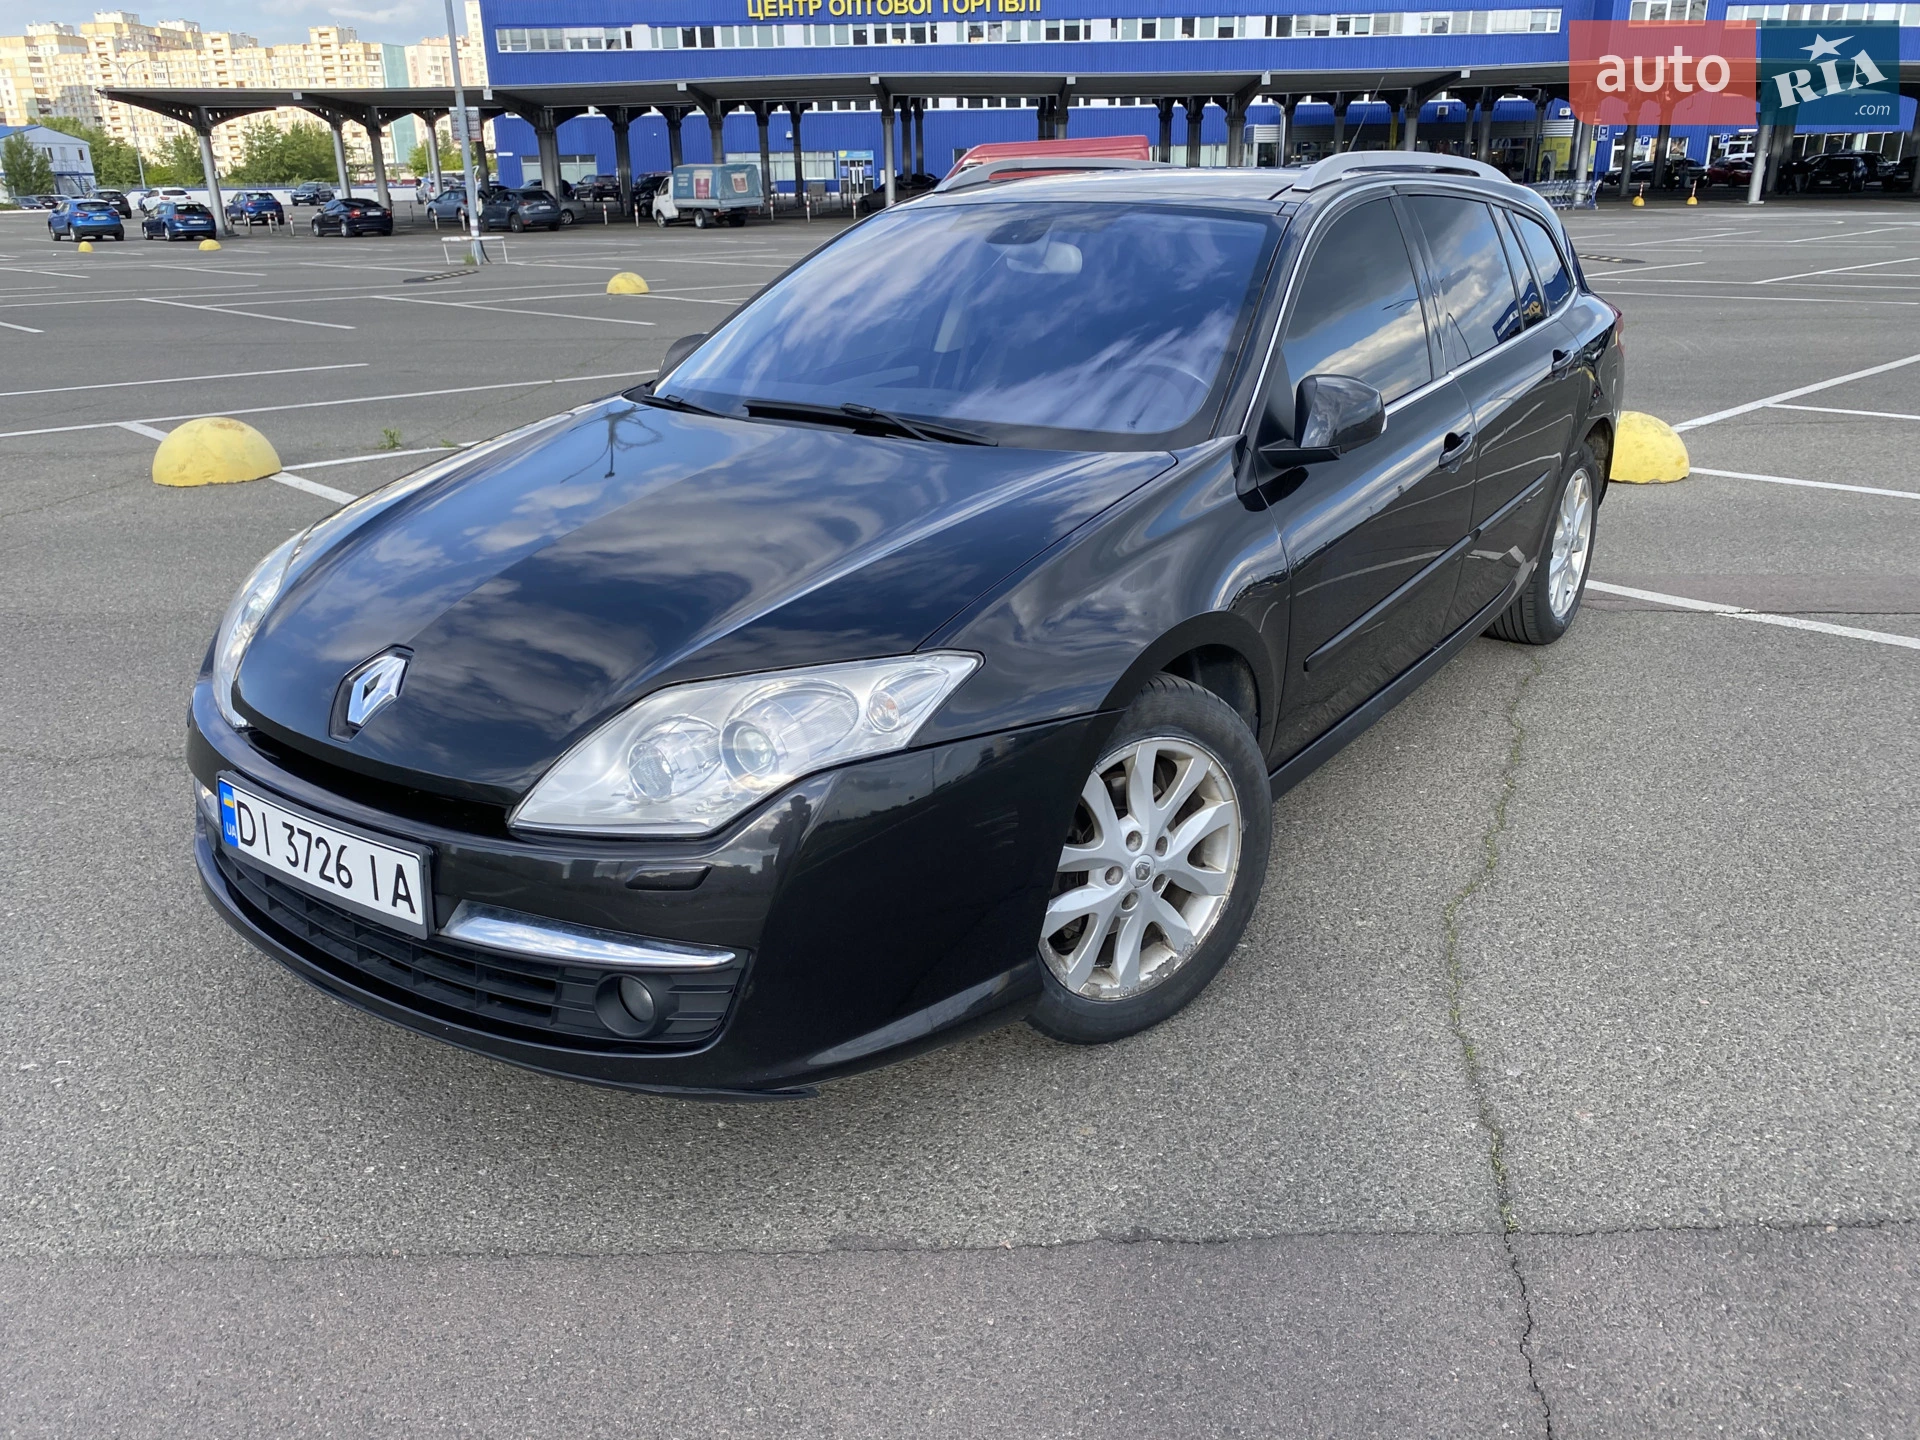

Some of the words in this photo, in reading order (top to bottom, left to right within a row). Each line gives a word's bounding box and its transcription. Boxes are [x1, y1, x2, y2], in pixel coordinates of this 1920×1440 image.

[747, 0, 822, 20] ЦЕНТР
[1642, 136, 1649, 145] P
[1721, 134, 1728, 143] P
[226, 822, 237, 839] UA
[236, 800, 271, 857] DI
[282, 821, 353, 889] 3726
[370, 854, 417, 915] IA
